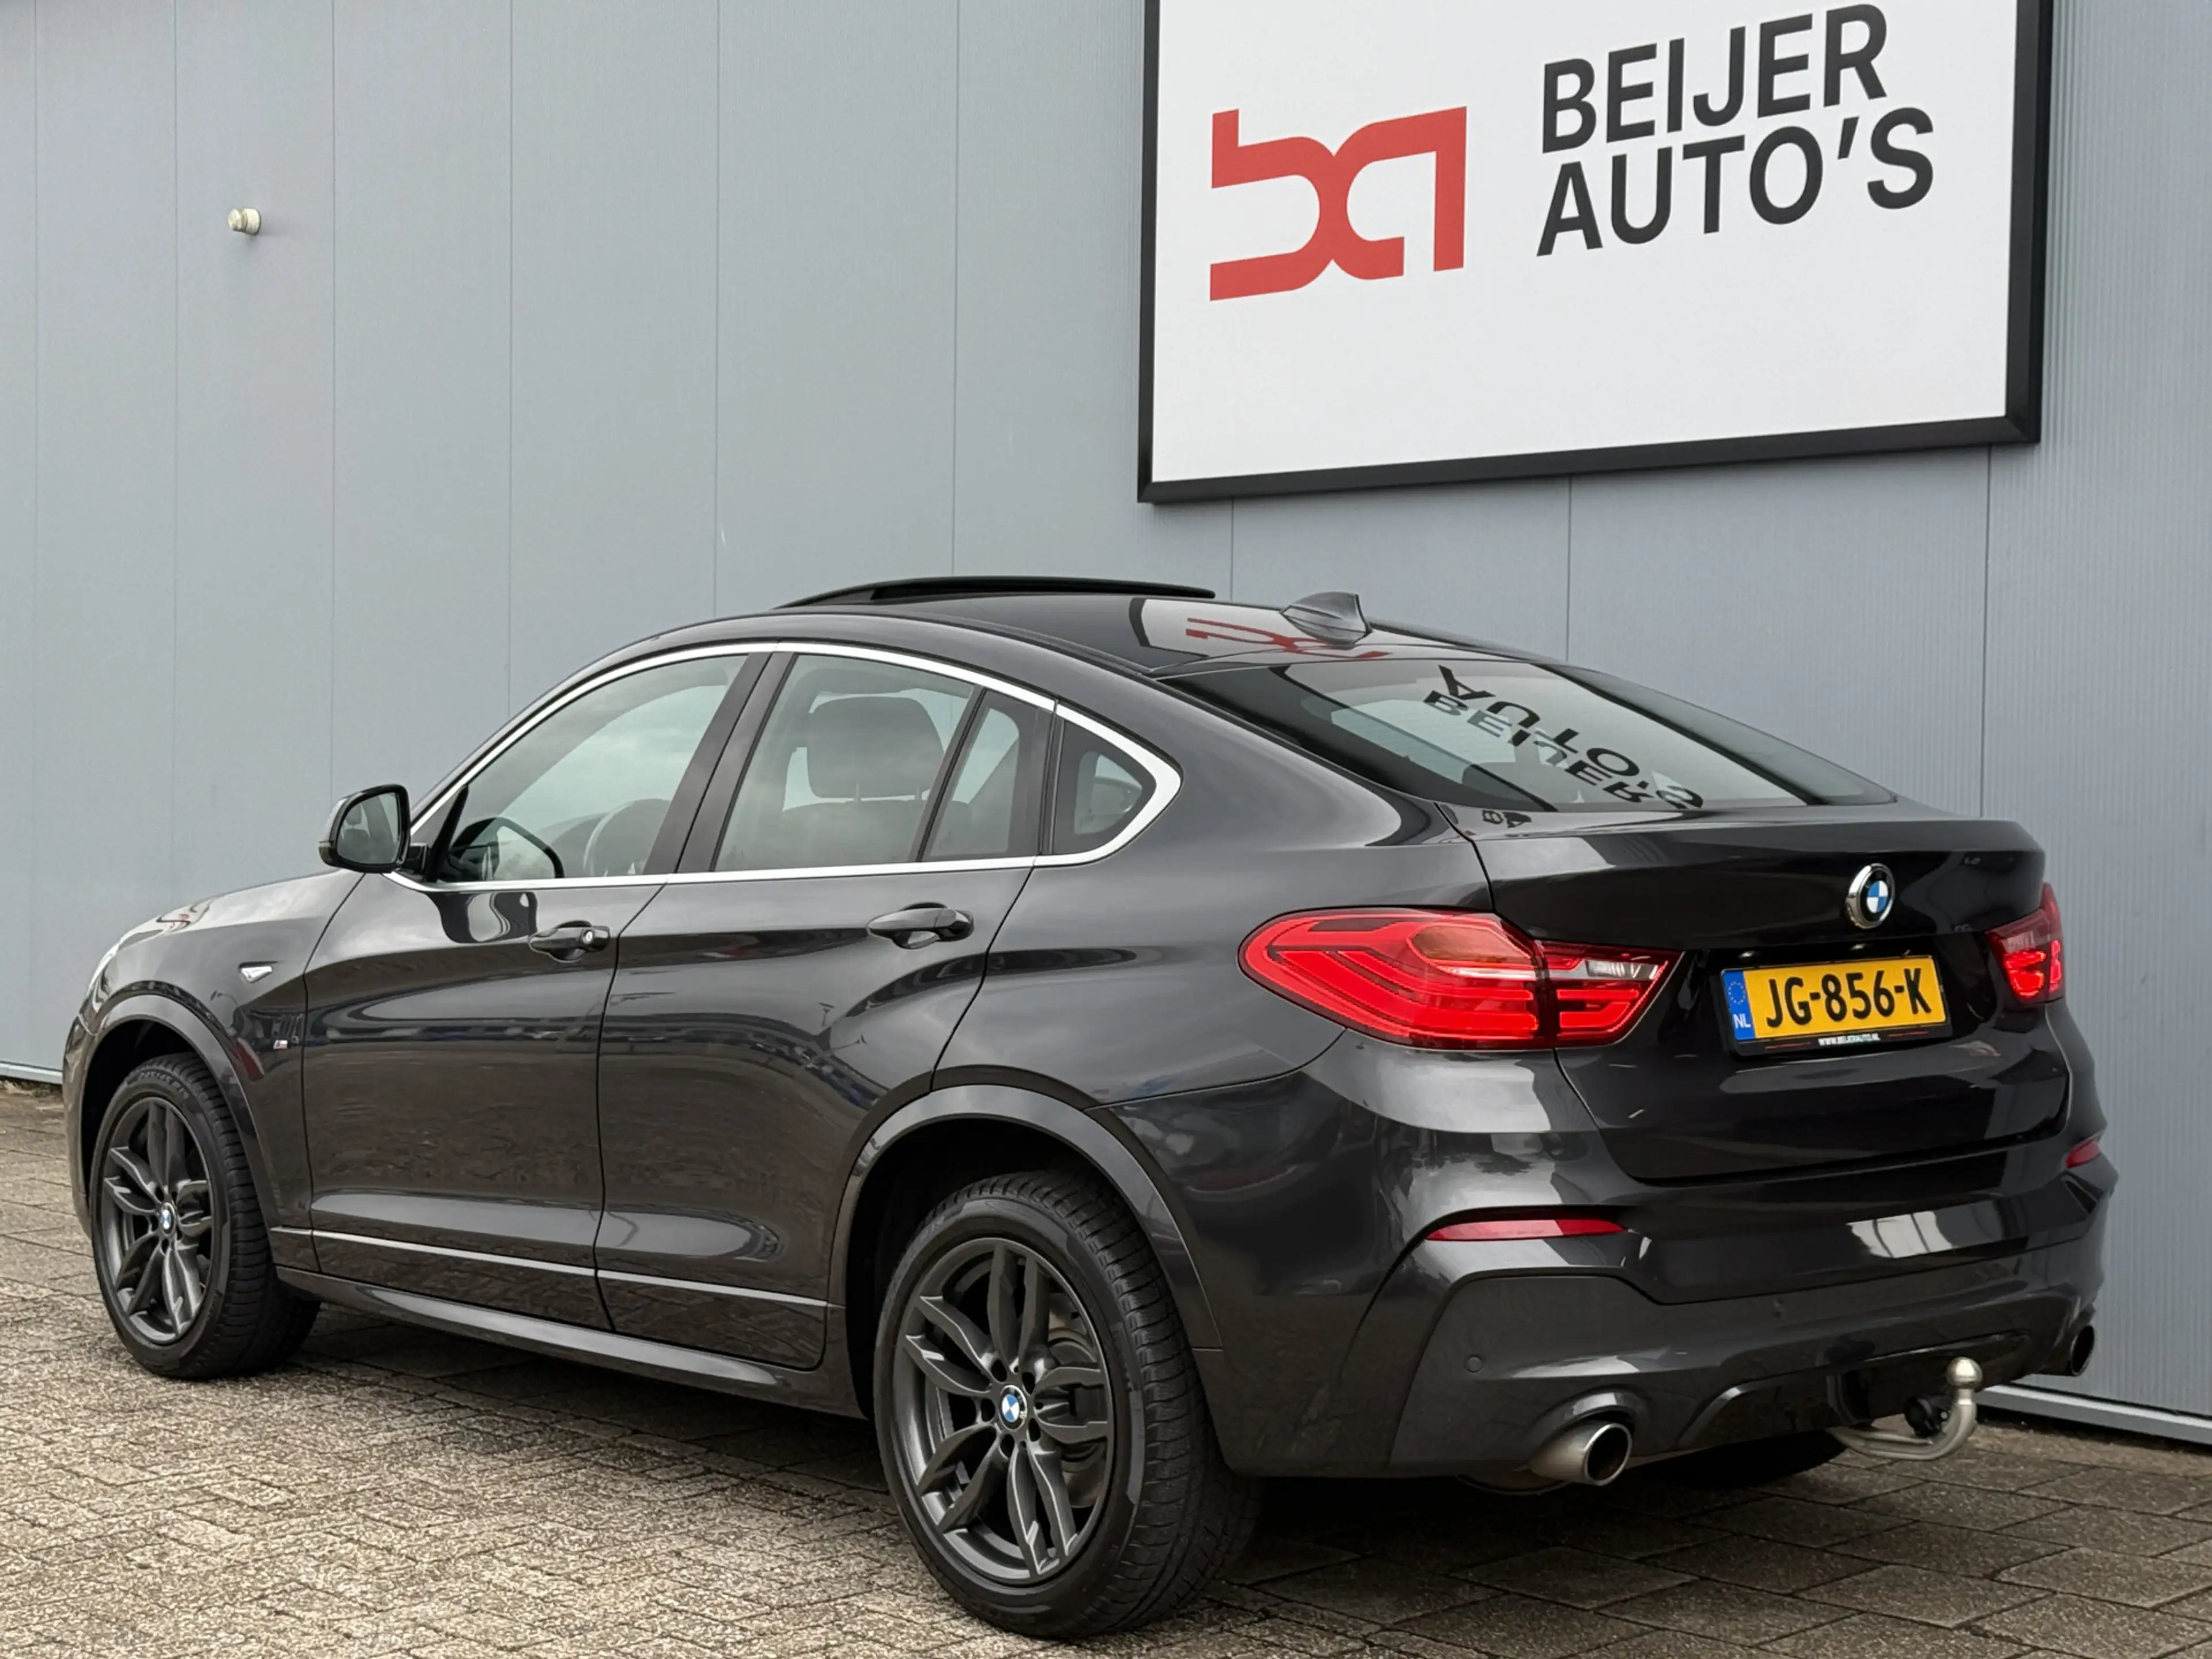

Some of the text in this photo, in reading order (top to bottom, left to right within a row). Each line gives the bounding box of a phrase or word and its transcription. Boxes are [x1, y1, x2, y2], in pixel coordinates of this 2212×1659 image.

[1543, 5, 1887, 153] BEIJER
[1537, 108, 1933, 256] AUTO'S
[1733, 1013, 1751, 1028] NL
[1767, 968, 1931, 1028] JG-856-K
